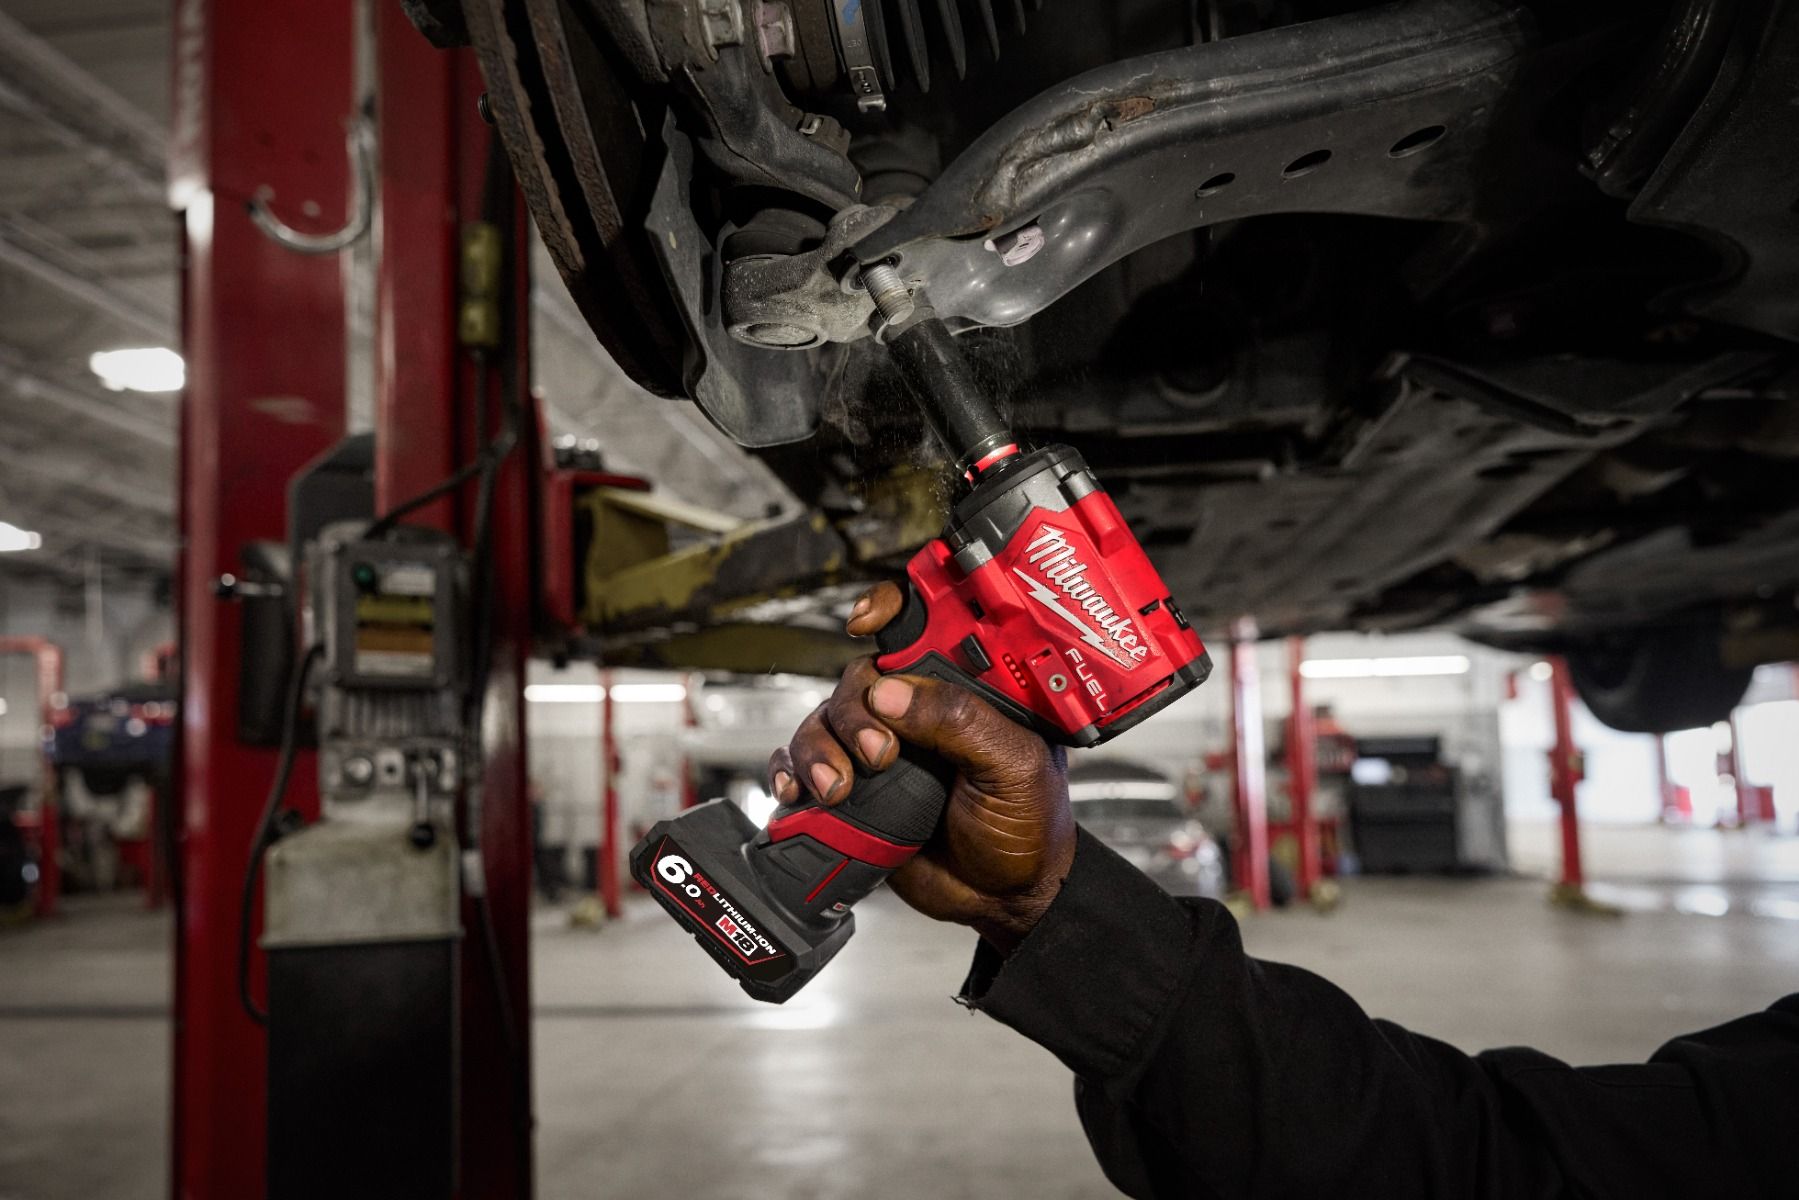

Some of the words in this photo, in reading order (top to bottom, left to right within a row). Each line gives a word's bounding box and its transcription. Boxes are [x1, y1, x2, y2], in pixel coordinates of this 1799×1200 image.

[1025, 524, 1148, 662] Milwaukee
[1065, 648, 1106, 712] FUEL
[657, 854, 701, 898] 6.0
[718, 916, 756, 953] M18
